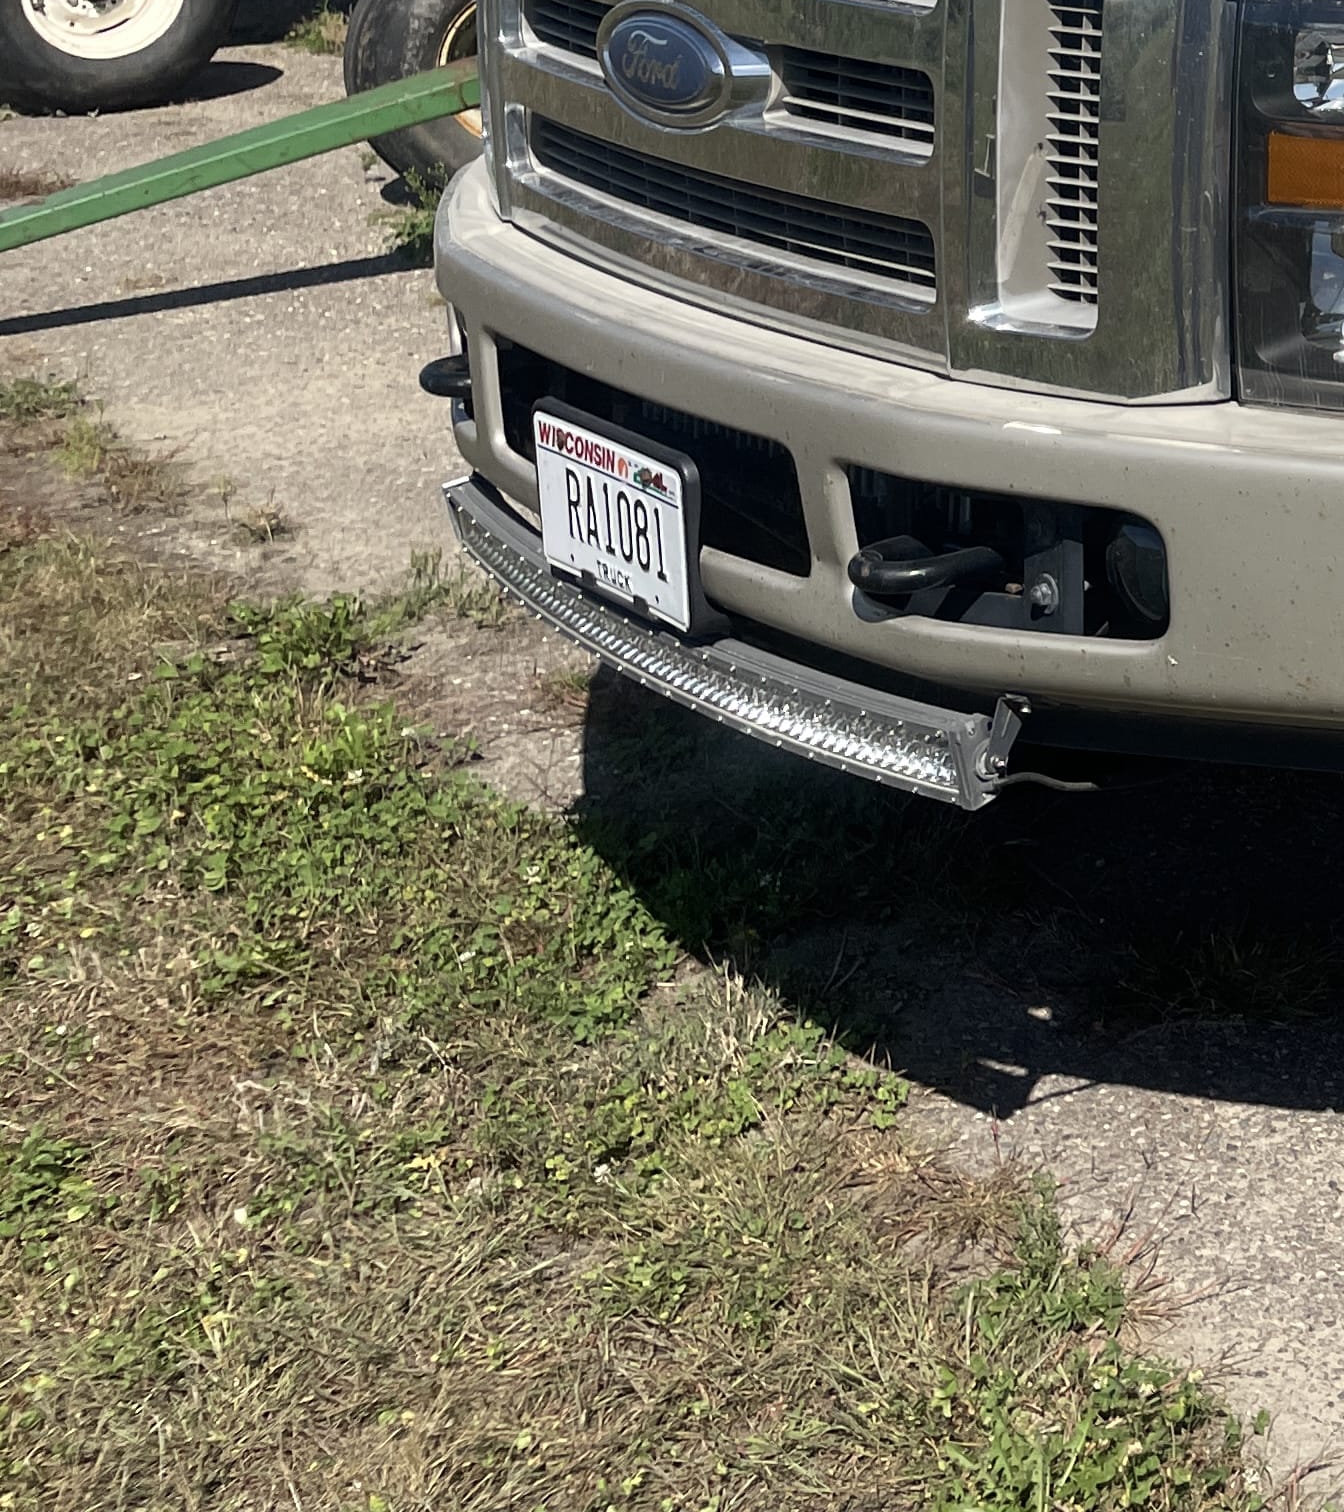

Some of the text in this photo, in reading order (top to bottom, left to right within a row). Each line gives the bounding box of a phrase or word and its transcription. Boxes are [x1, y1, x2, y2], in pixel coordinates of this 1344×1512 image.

[622, 30, 684, 89] Ford
[566, 467, 668, 584] RA1081
[596, 559, 633, 592] TRUCK
